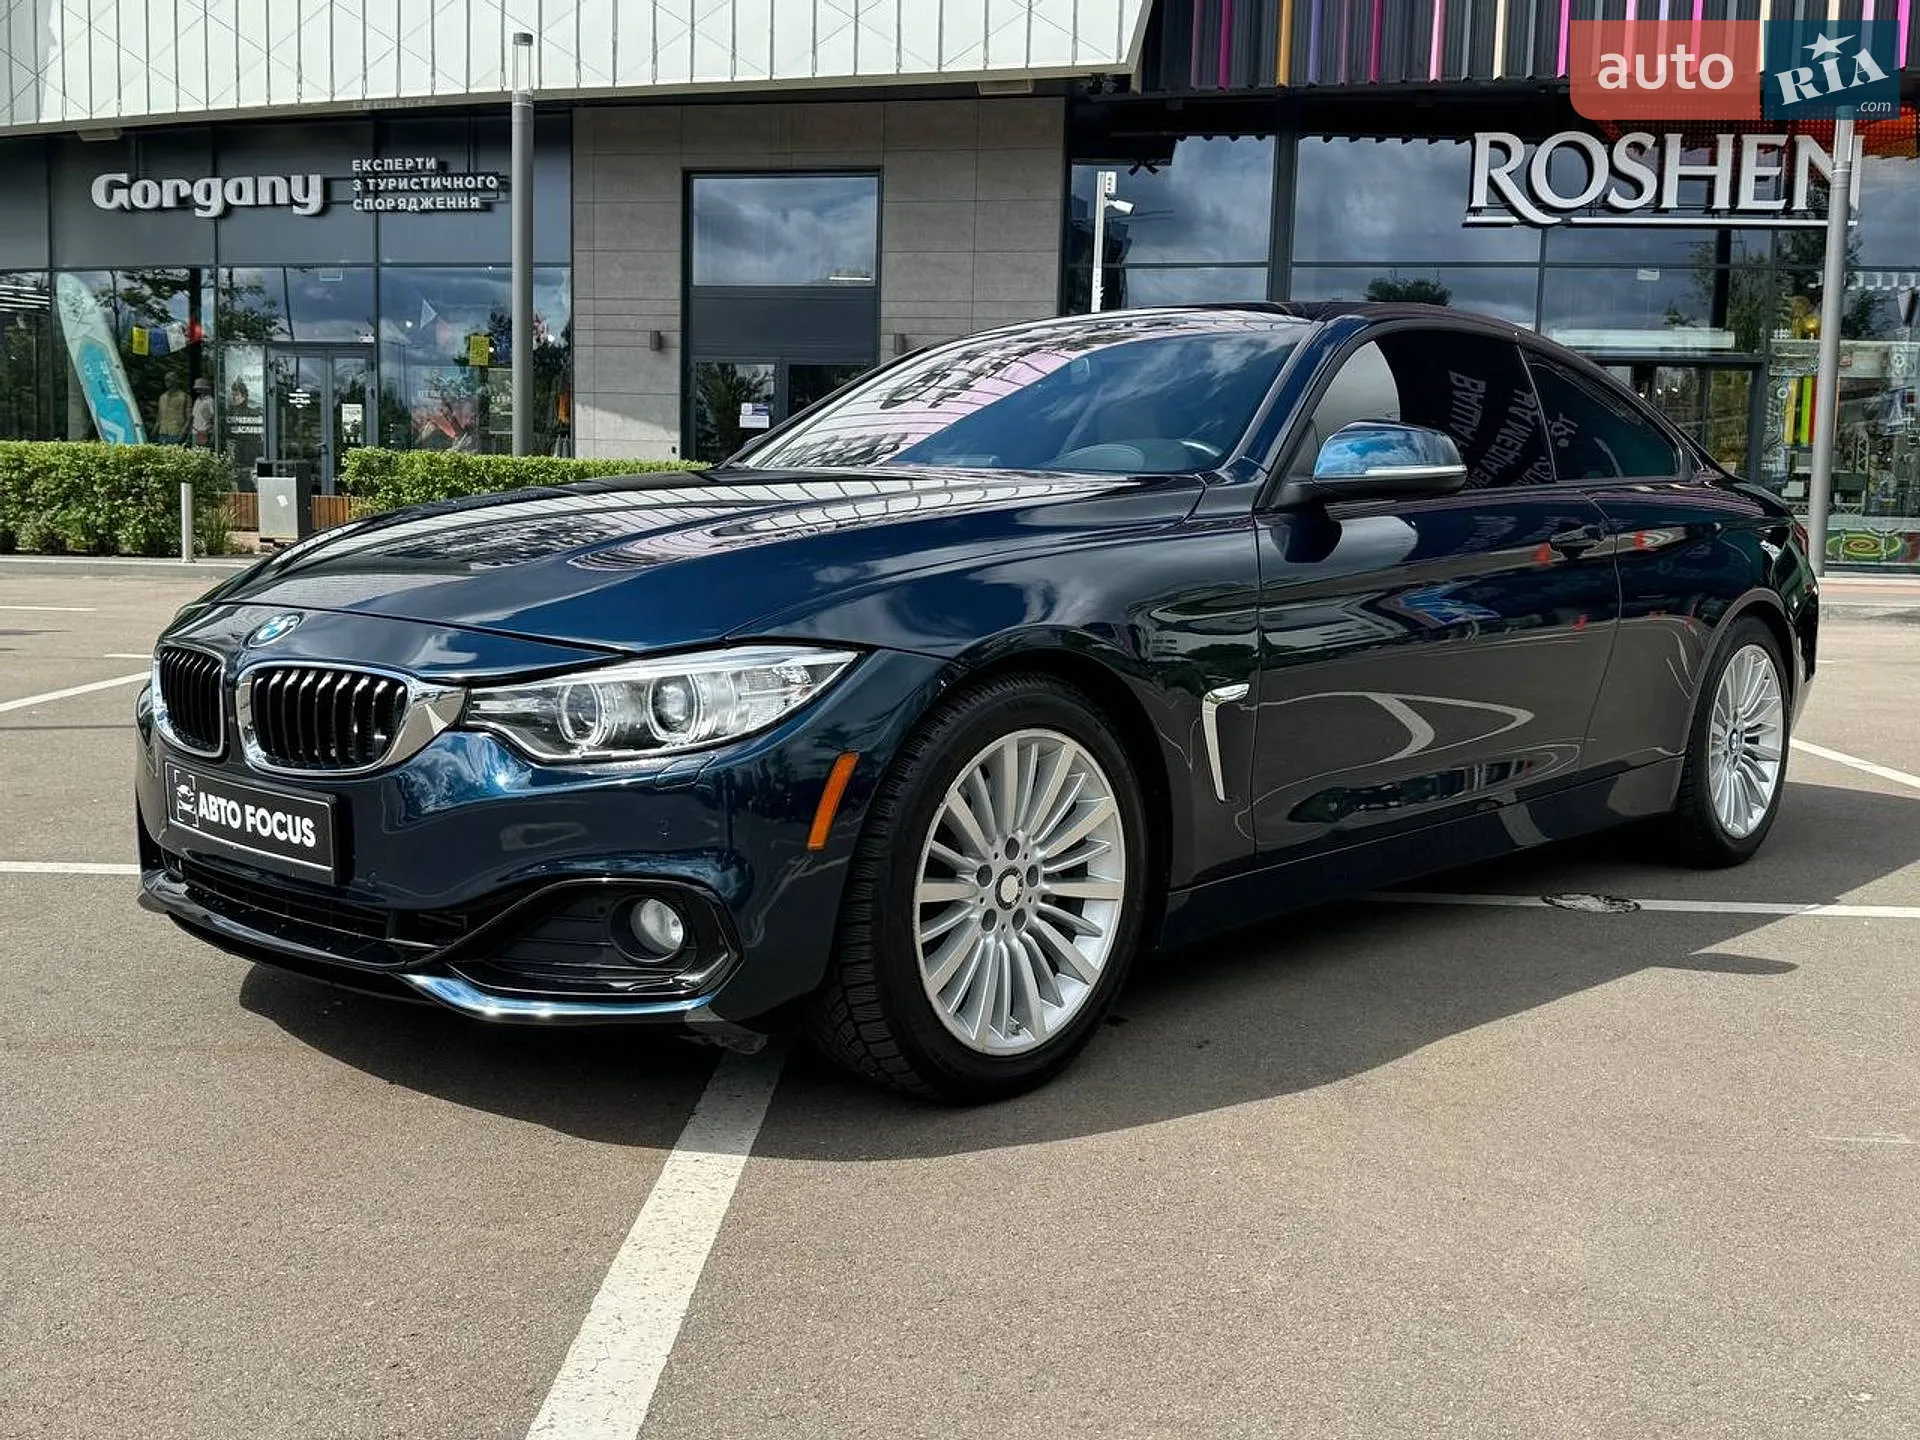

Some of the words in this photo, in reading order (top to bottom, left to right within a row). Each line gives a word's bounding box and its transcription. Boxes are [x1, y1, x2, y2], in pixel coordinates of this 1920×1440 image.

[352, 157, 437, 172] ЕКСПЕРТИ
[1470, 131, 1864, 225] ROSHEN
[91, 173, 324, 218] Gorgany
[367, 176, 498, 191] ТУРИСТИЧНОГО
[352, 196, 481, 212] СПОРЯДЖЕННЯ
[198, 791, 241, 829] АВТО
[245, 804, 316, 848] FOCUS
